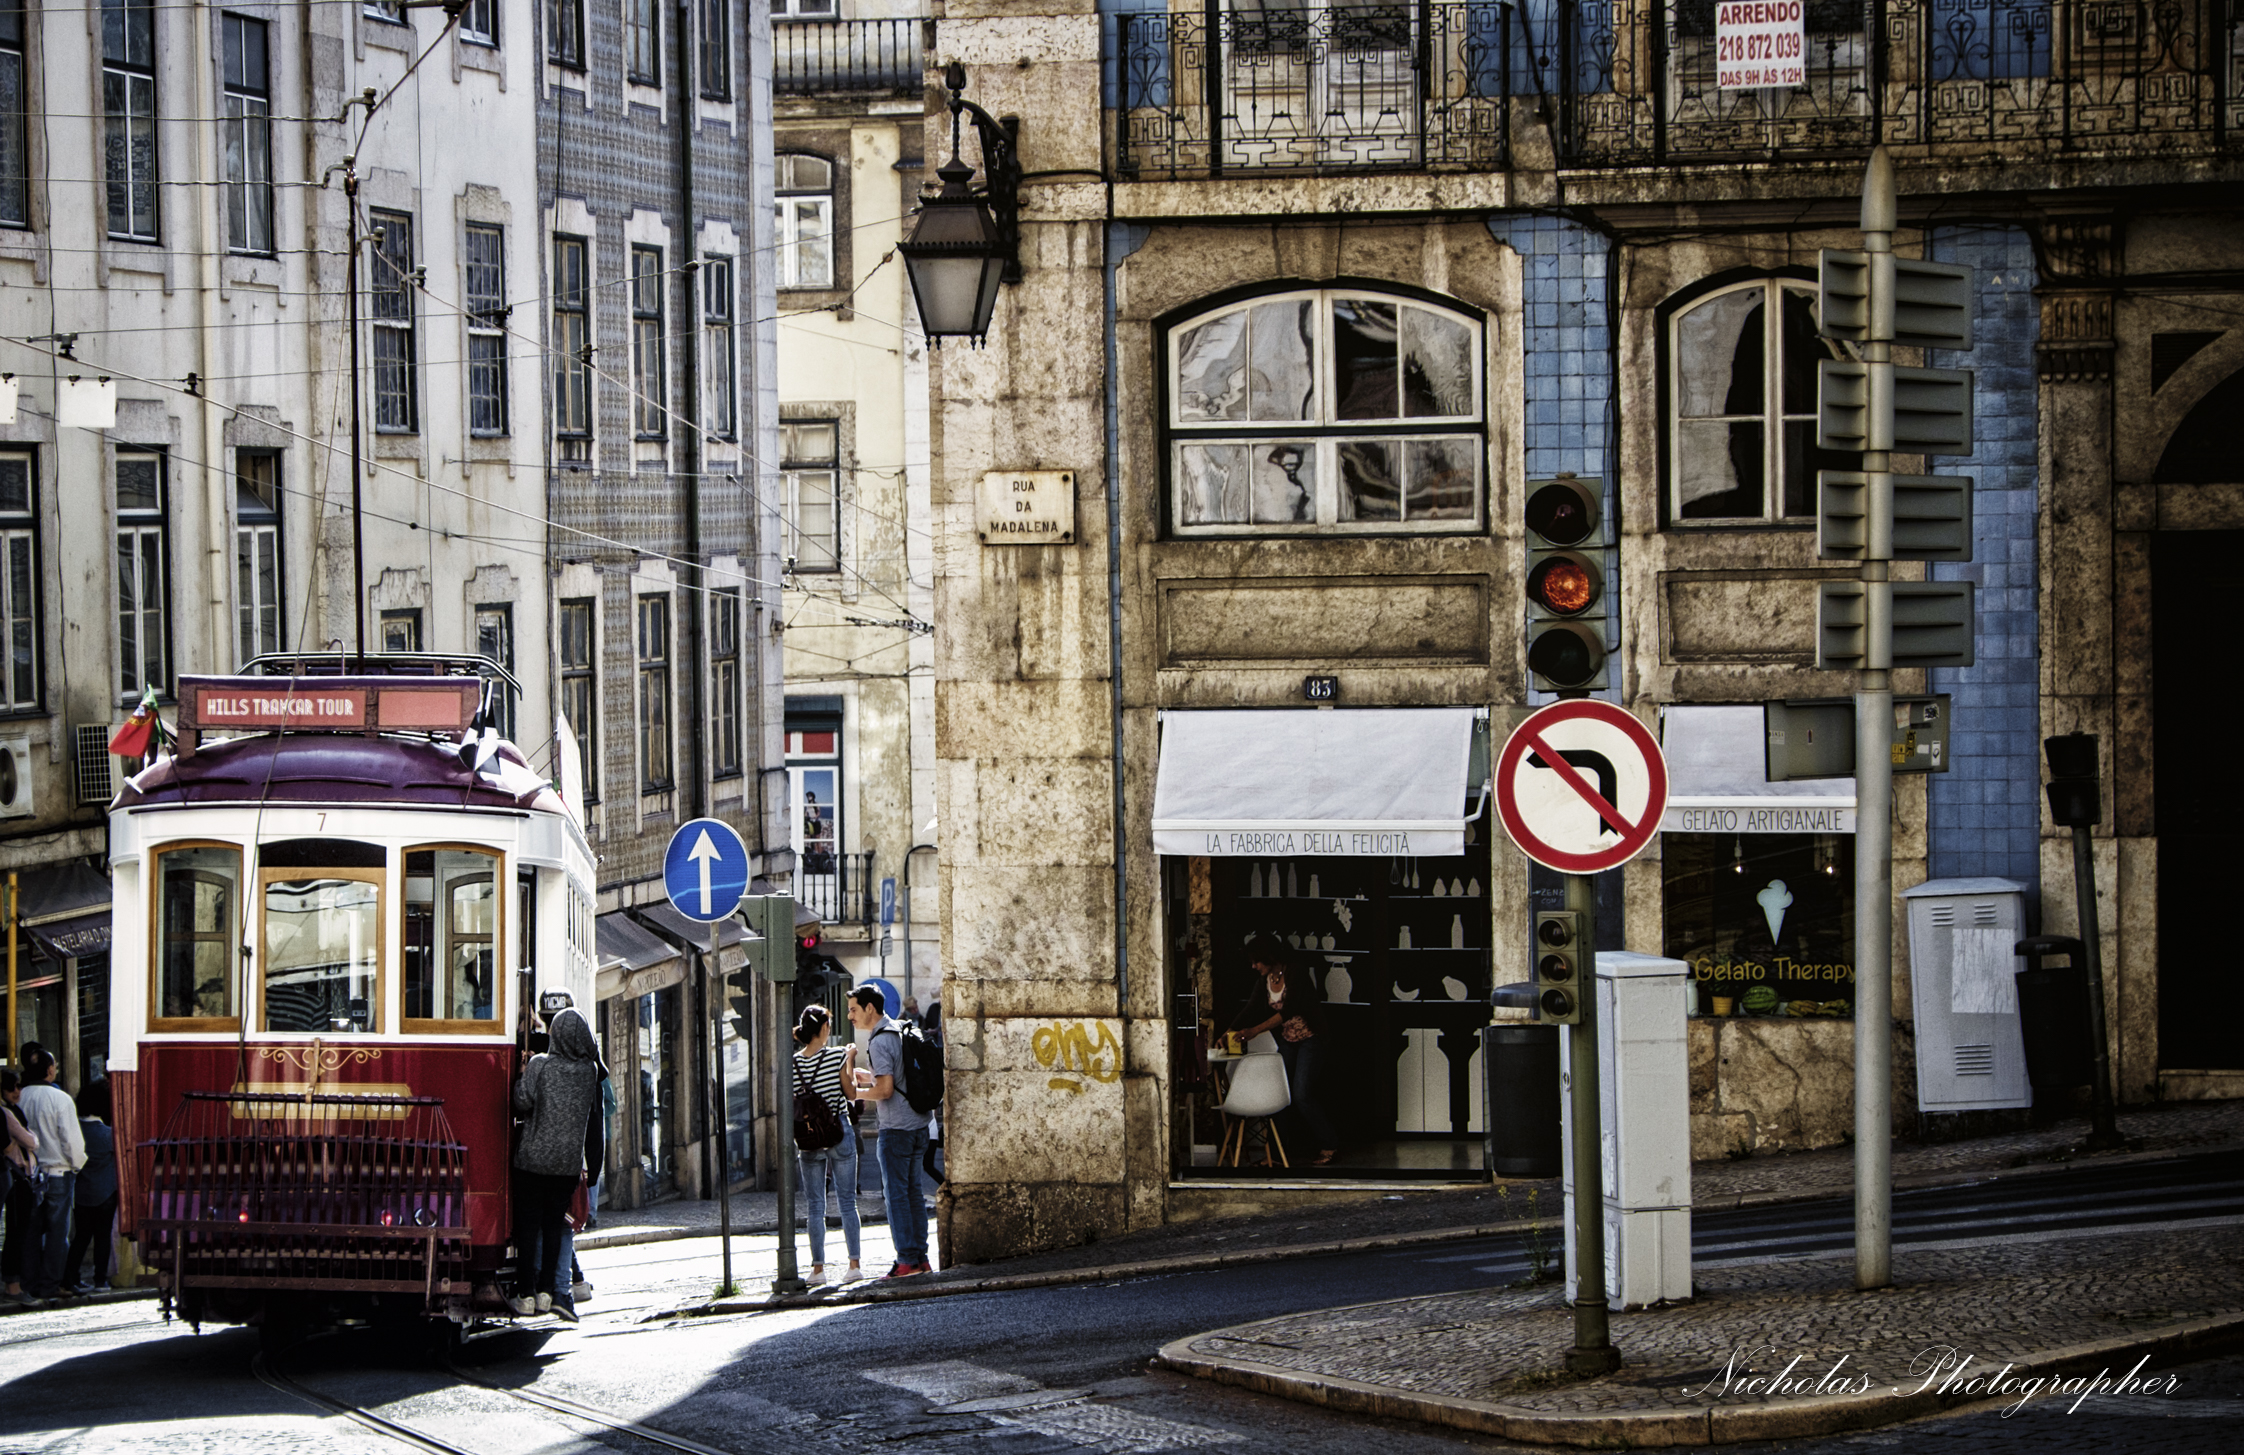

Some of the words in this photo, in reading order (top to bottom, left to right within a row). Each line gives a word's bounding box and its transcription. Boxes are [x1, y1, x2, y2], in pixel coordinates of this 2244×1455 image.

[1719, 1, 1800, 25] ARRENDO
[1719, 34, 1744, 61] 218
[1747, 33, 1772, 60] 872
[1776, 31, 1800, 59] 039
[1720, 70, 1742, 86] DAS
[1745, 69, 1760, 85] 9H
[1763, 65, 1778, 84] ÀS
[1781, 67, 1802, 83] 12H
[1012, 480, 1035, 492] RUA
[1015, 500, 1032, 512] DA
[990, 521, 1058, 533] MADALENA
[1310, 679, 1332, 697] 83
[207, 698, 250, 716] HILLS
[252, 698, 314, 716] TRAMCAR
[317, 698, 354, 716] TOUR
[317, 812, 327, 832] 7
[1682, 809, 1738, 831] GELATO
[1747, 809, 1844, 831] ARTIGIANALE
[1206, 833, 1222, 853] LA
[1230, 833, 1296, 853] FABBRICA
[1303, 833, 1344, 853] DELLA
[1352, 831, 1410, 854] FELICITÀ
[884, 882, 893, 921] P
[53, 930, 94, 951] PASTELARIA
[1694, 957, 1766, 982] Gelato
[1772, 956, 1856, 984] Therapy
